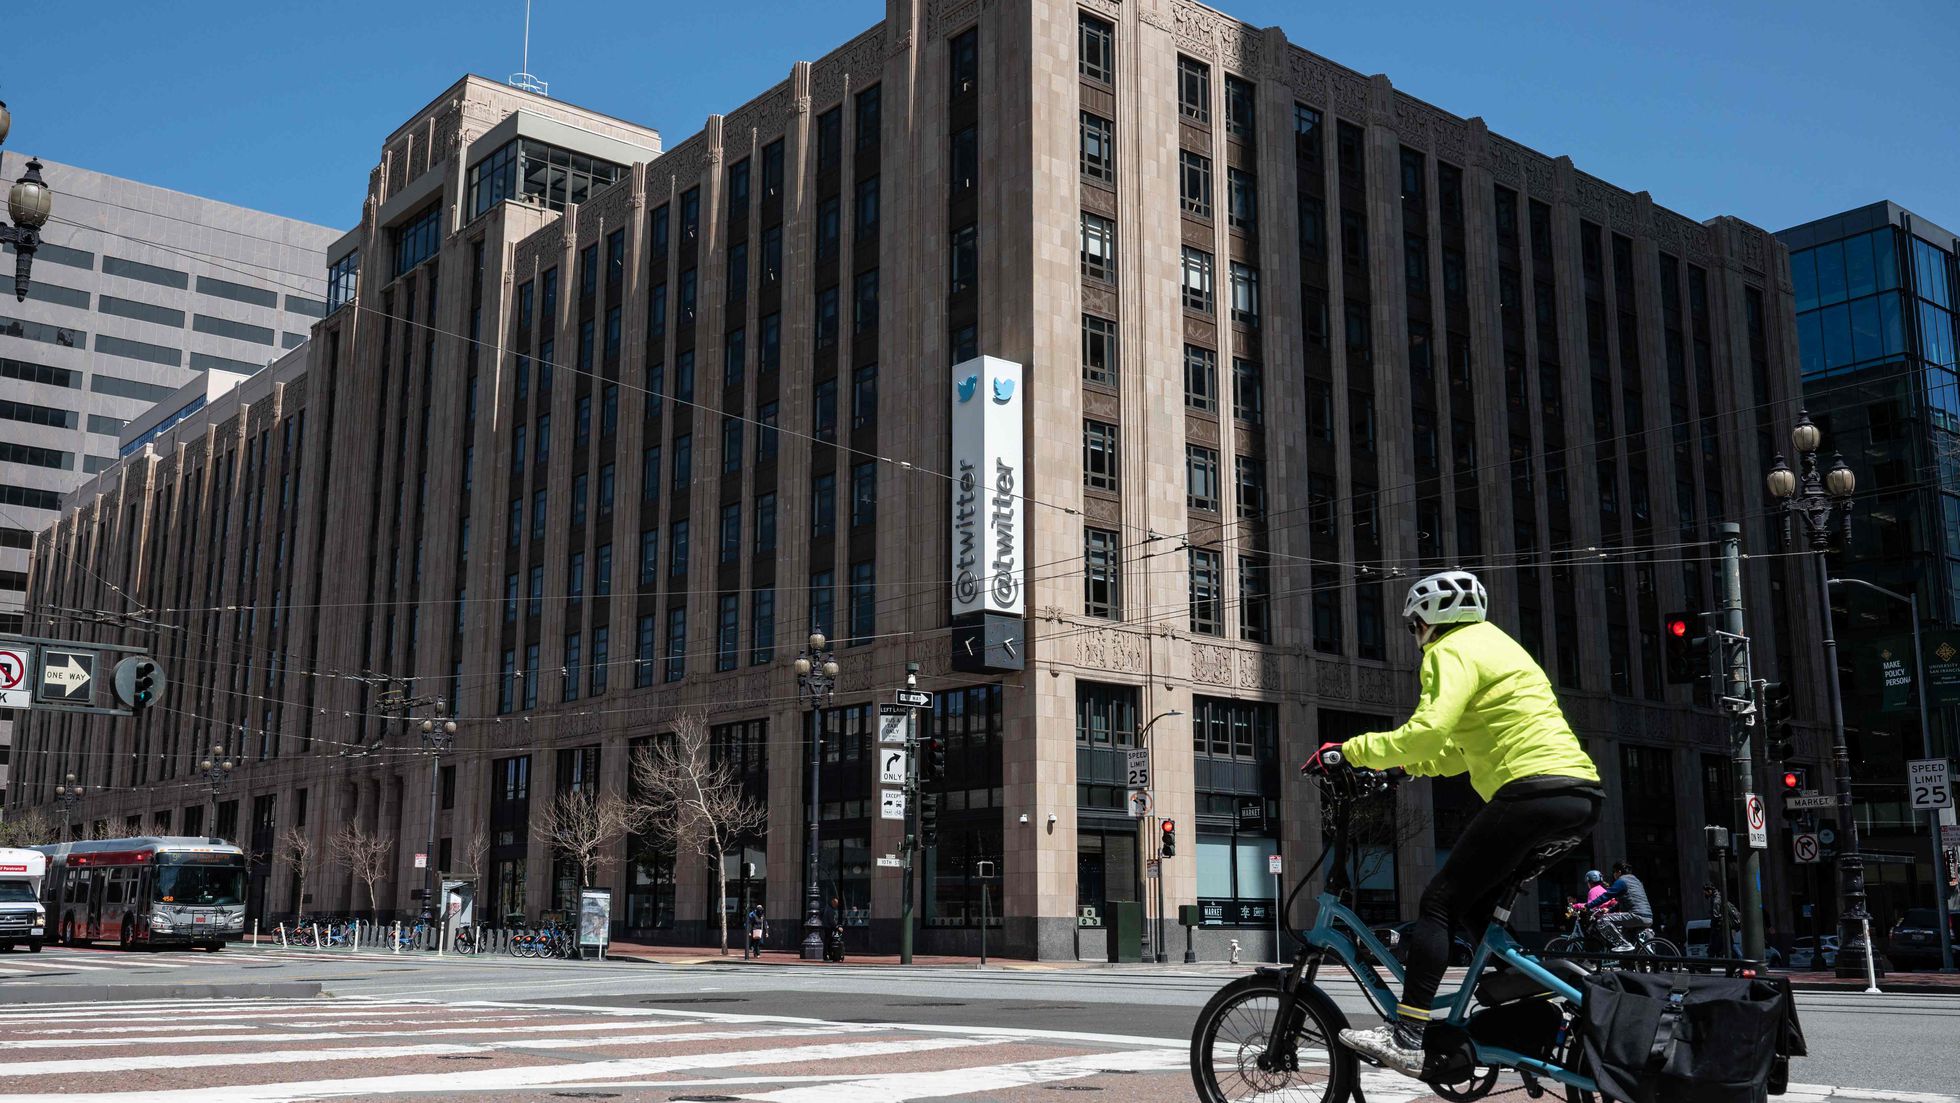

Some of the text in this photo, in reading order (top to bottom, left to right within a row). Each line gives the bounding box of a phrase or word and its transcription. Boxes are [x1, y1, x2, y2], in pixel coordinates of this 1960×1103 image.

[956, 459, 979, 604] @twitter
[991, 457, 1019, 609] @twitter
[1883, 660, 1901, 670] MAKE
[46, 671, 86, 681] ONE WAY
[1885, 668, 1905, 678] POLICY
[1128, 751, 1148, 760] SPEED
[1130, 760, 1145, 768] LIMIT
[1911, 764, 1945, 773] SPEED
[883, 773, 902, 781] ONLY
[1129, 769, 1148, 785] 25
[1914, 775, 1943, 784] LIMIT
[1915, 786, 1947, 805] 25
[1794, 797, 1829, 807] MARKET
[1241, 808, 1260, 817] MARKET
[1750, 833, 1765, 843] ON RED
[1204, 907, 1222, 916] MARKET
